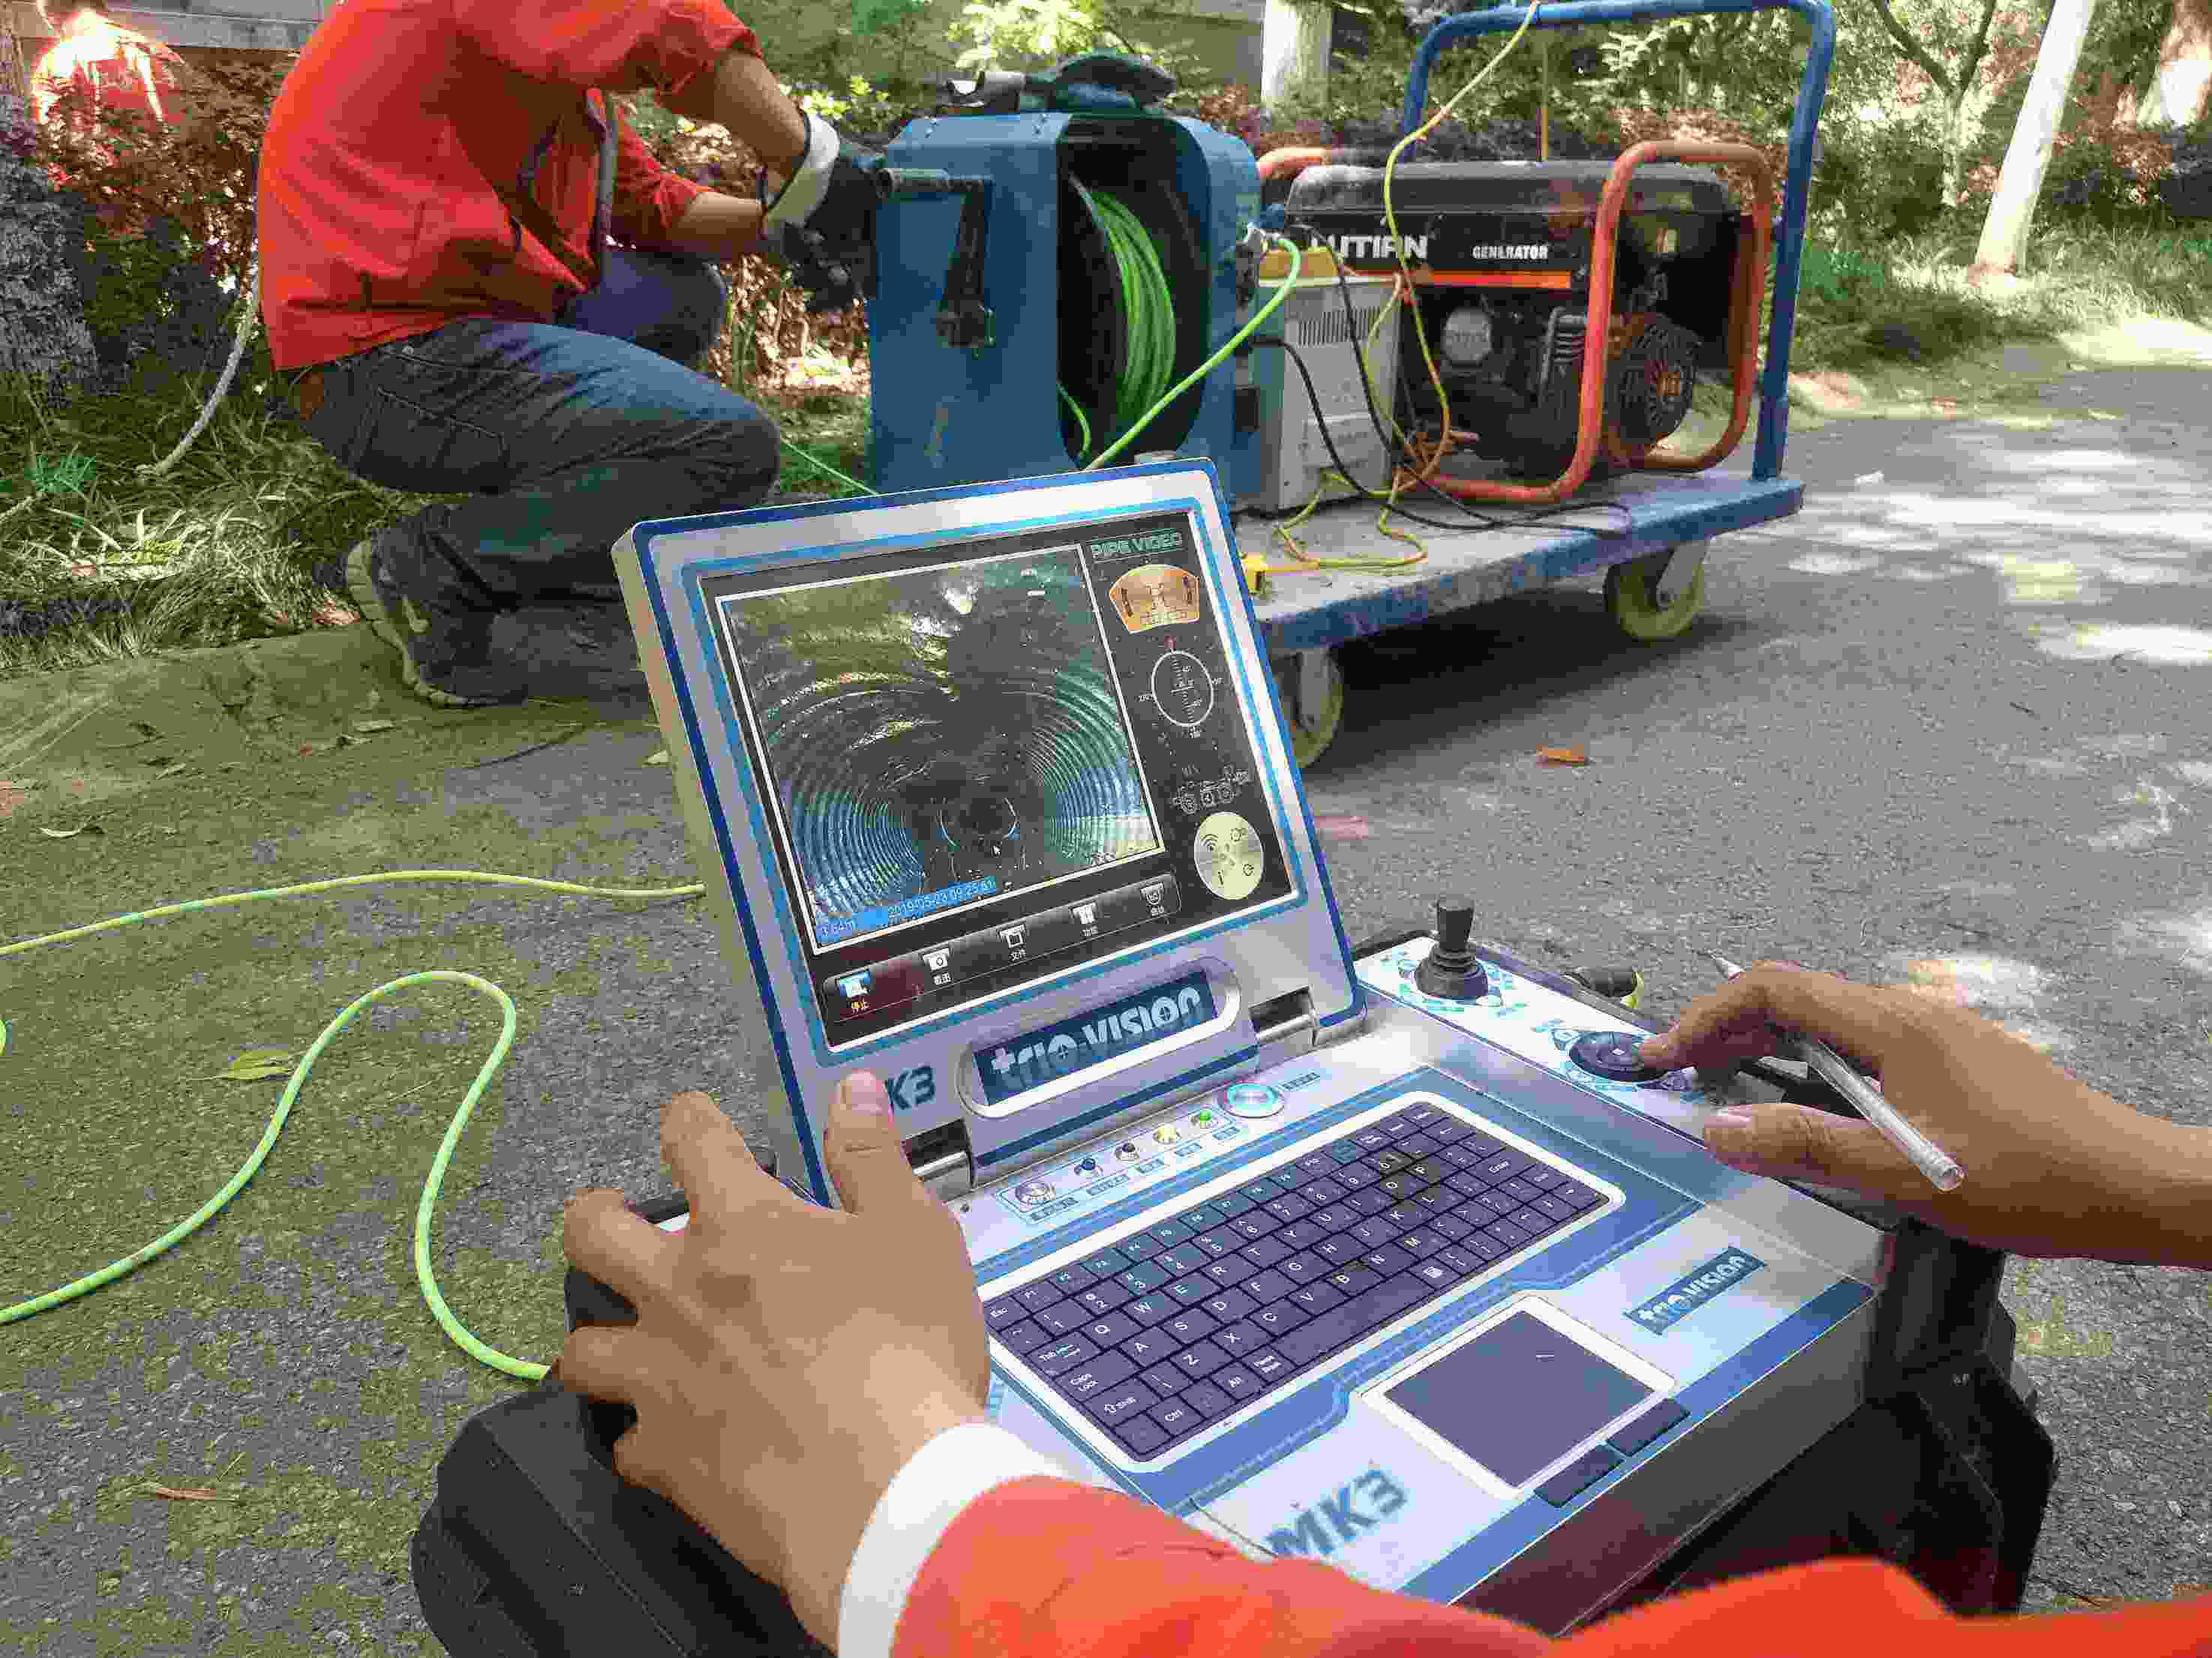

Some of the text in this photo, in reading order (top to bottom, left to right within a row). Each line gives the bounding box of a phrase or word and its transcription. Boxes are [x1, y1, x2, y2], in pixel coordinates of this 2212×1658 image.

[1472, 244, 1549, 260] GENERATOR
[1131, 532, 1183, 553] VIDEO
[888, 891, 947, 915] 2019-05-23
[1009, 948, 1028, 961] 文件
[851, 997, 870, 1012] 停止
[885, 1065, 935, 1111] K3
[1134, 1342, 1151, 1353] A
[1175, 1321, 1189, 1332] S
[1213, 1301, 1228, 1312] D
[1287, 1261, 1303, 1272] G
[1323, 1243, 1338, 1254] H
[1488, 1160, 1511, 1174] Enter
[1094, 1324, 1111, 1334] Q
[1134, 1300, 1153, 1314] W
[1174, 1283, 1189, 1295] E
[1211, 1265, 1228, 1276] R
[1183, 1354, 1200, 1366] Z
[1224, 1332, 1241, 1343] X
[1262, 1312, 1277, 1322] C
[1299, 1291, 1314, 1302] V
[1370, 1254, 1385, 1265] N
[989, 1306, 1009, 1318] Esc
[1164, 1409, 1184, 1422] Ctrl
[1265, 1471, 1407, 1555] MK3
